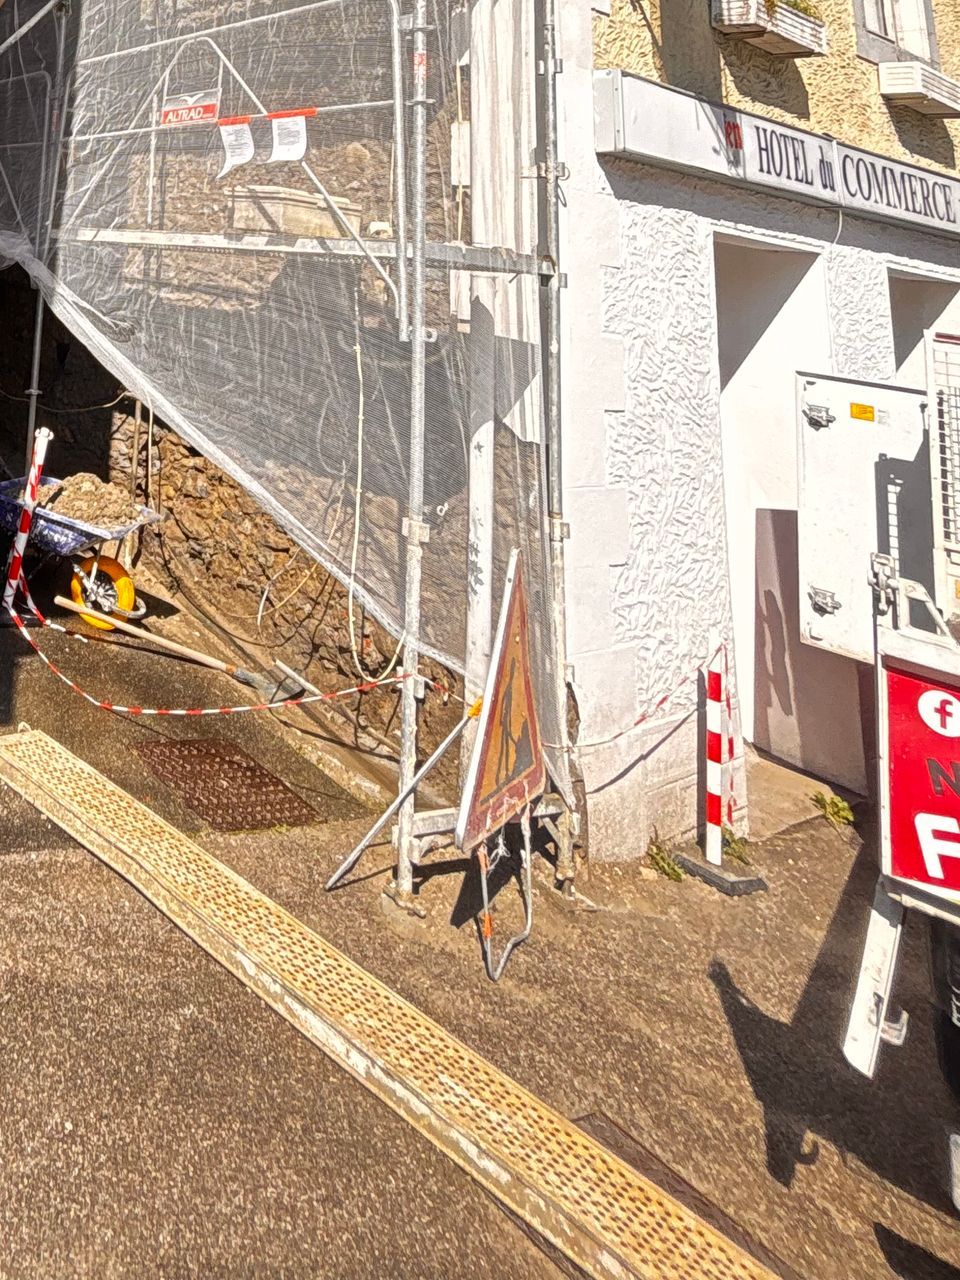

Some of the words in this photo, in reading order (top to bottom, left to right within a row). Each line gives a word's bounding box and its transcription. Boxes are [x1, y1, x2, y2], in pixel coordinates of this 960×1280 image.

[166, 107, 204, 122] ALTRAD
[754, 125, 814, 186] HOTEL
[818, 145, 836, 192] du
[842, 154, 957, 224] COMMERCE
